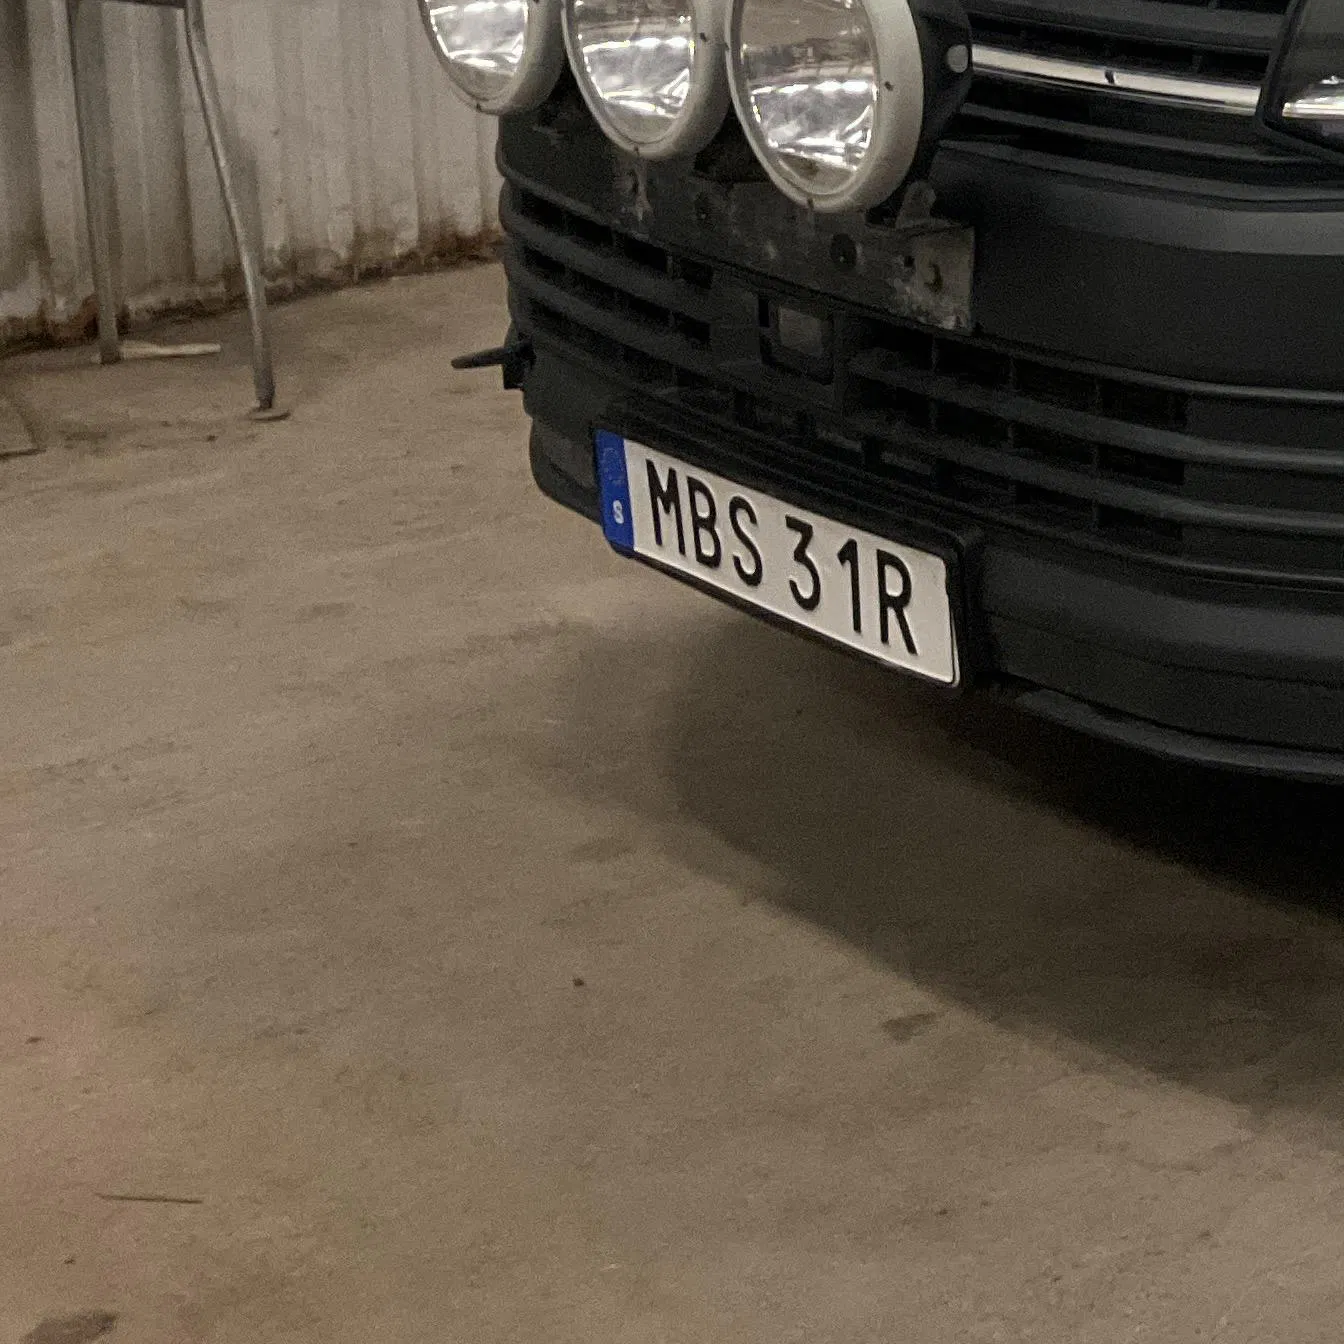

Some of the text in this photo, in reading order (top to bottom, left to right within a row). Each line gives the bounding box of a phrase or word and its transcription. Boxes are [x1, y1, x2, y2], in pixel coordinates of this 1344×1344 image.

[612, 499, 624, 524] S
[646, 459, 918, 655] MBS 31R
